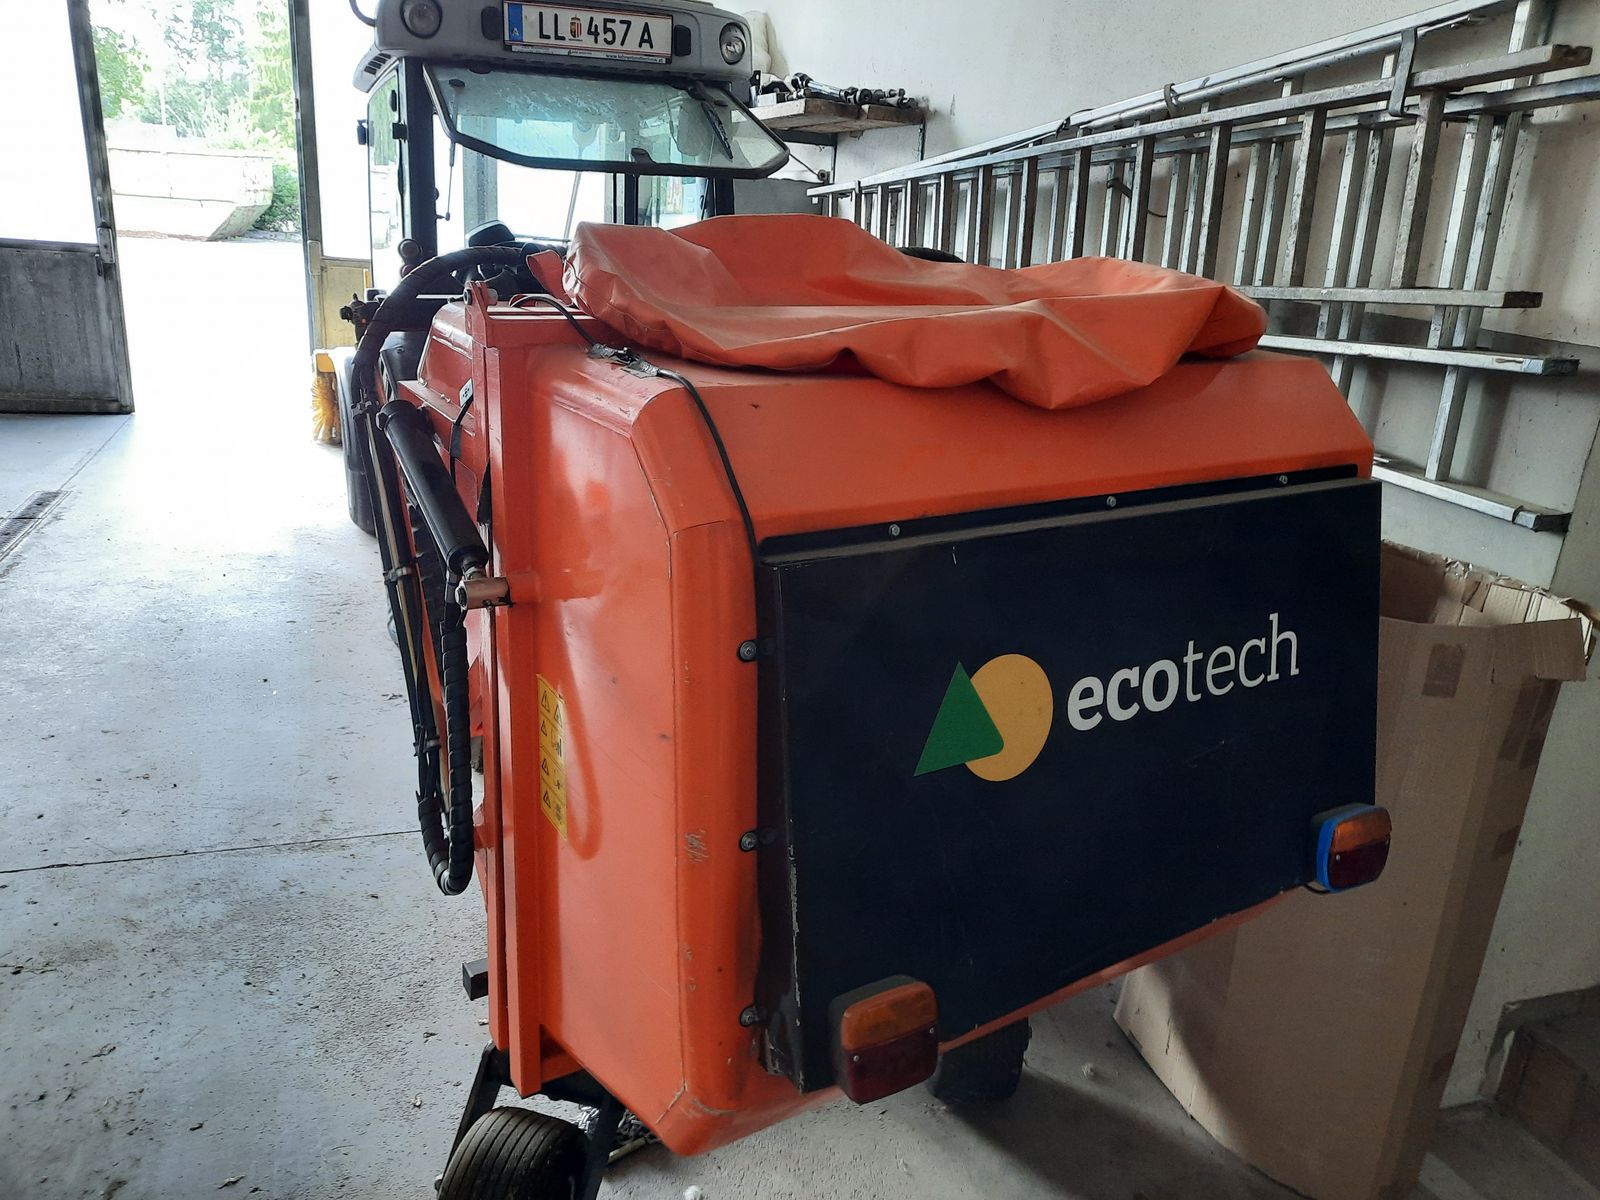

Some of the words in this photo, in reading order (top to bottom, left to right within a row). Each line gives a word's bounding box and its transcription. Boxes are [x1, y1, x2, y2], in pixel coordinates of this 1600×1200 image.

[512, 27, 520, 36] A
[539, 11, 566, 41] LL
[1067, 612, 1300, 732] ecotech
